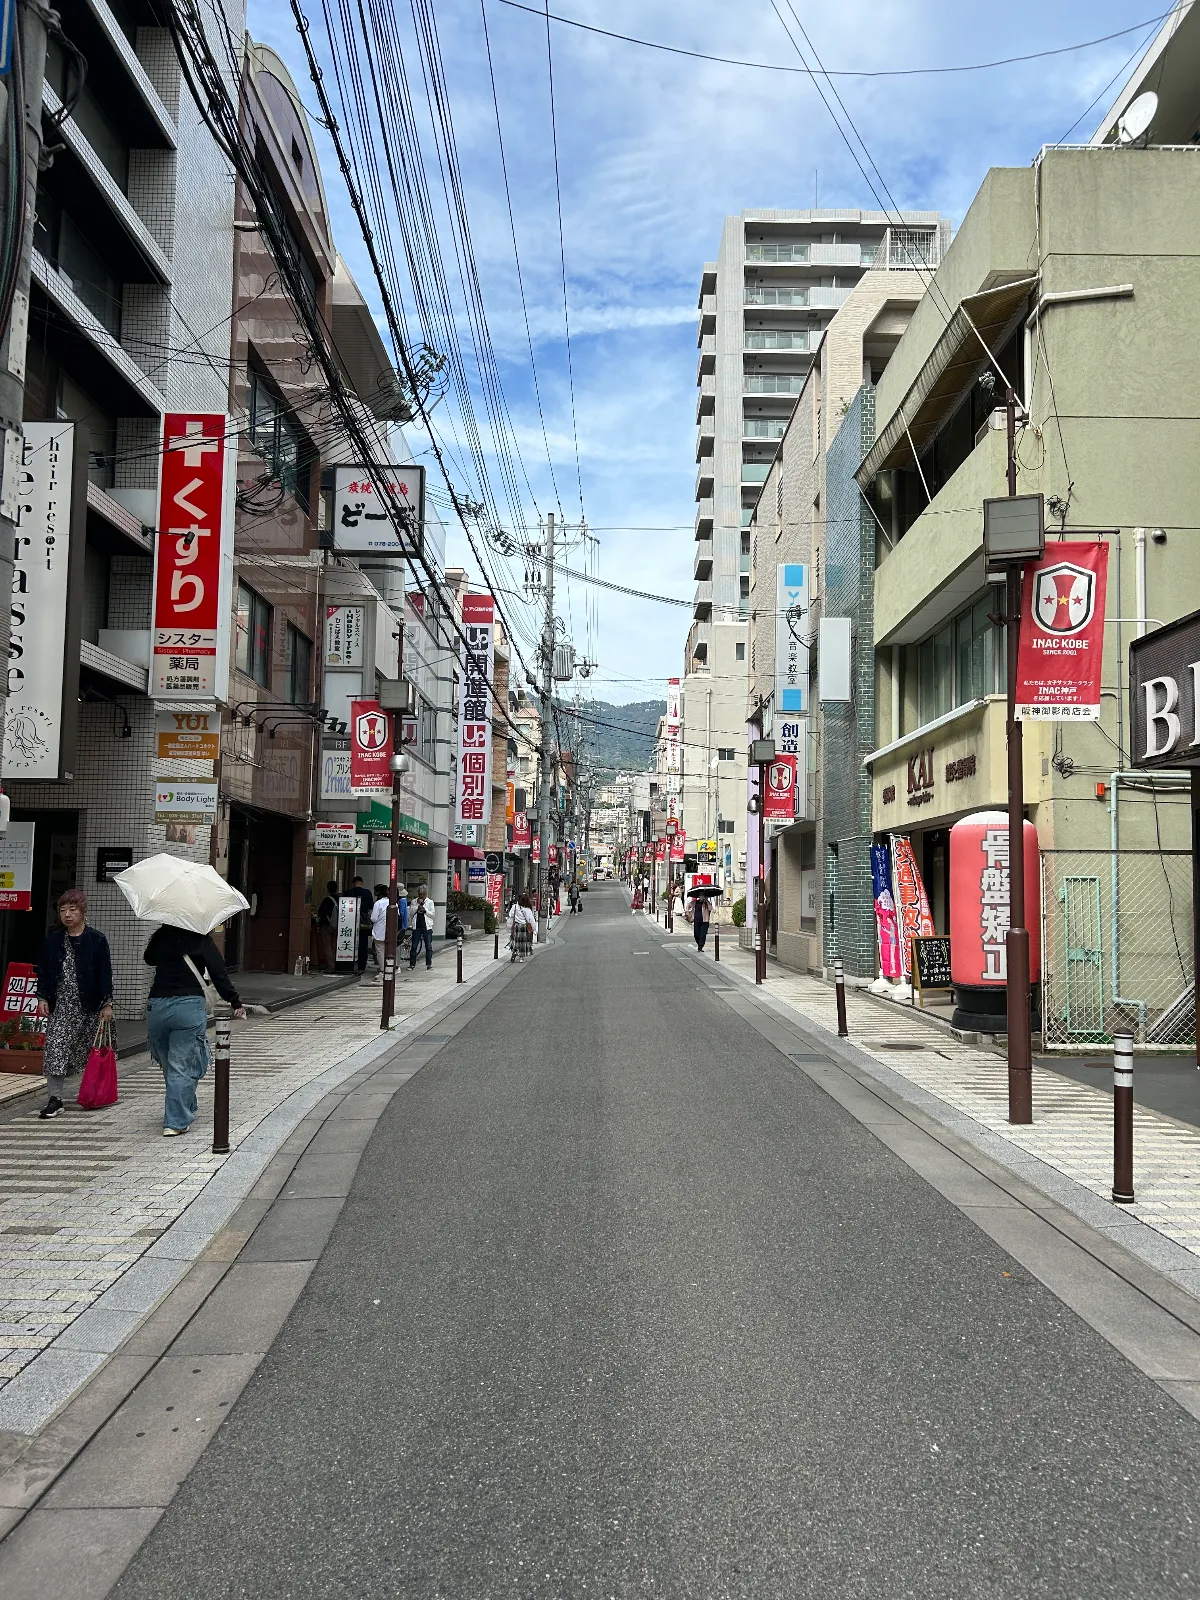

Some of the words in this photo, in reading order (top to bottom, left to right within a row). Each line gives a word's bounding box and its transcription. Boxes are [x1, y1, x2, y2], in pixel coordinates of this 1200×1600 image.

[48, 437, 60, 490] hair
[46, 501, 56, 570] resort
[168, 477, 212, 613] くすり
[158, 633, 214, 646] シスター
[1032, 638, 1060, 648] INAC
[1062, 639, 1089, 650] KOBE
[169, 656, 199, 670] 薬局
[1022, 706, 1092, 716] 阪神御影商店会
[172, 714, 210, 730] YUI
[906, 747, 934, 794] KAI
[461, 753, 486, 820] 個別館
[176, 796, 194, 804] Body
[196, 796, 215, 804] Light
[981, 829, 1010, 980] 骨盤矯正
[6, 998, 37, 1010] せん
